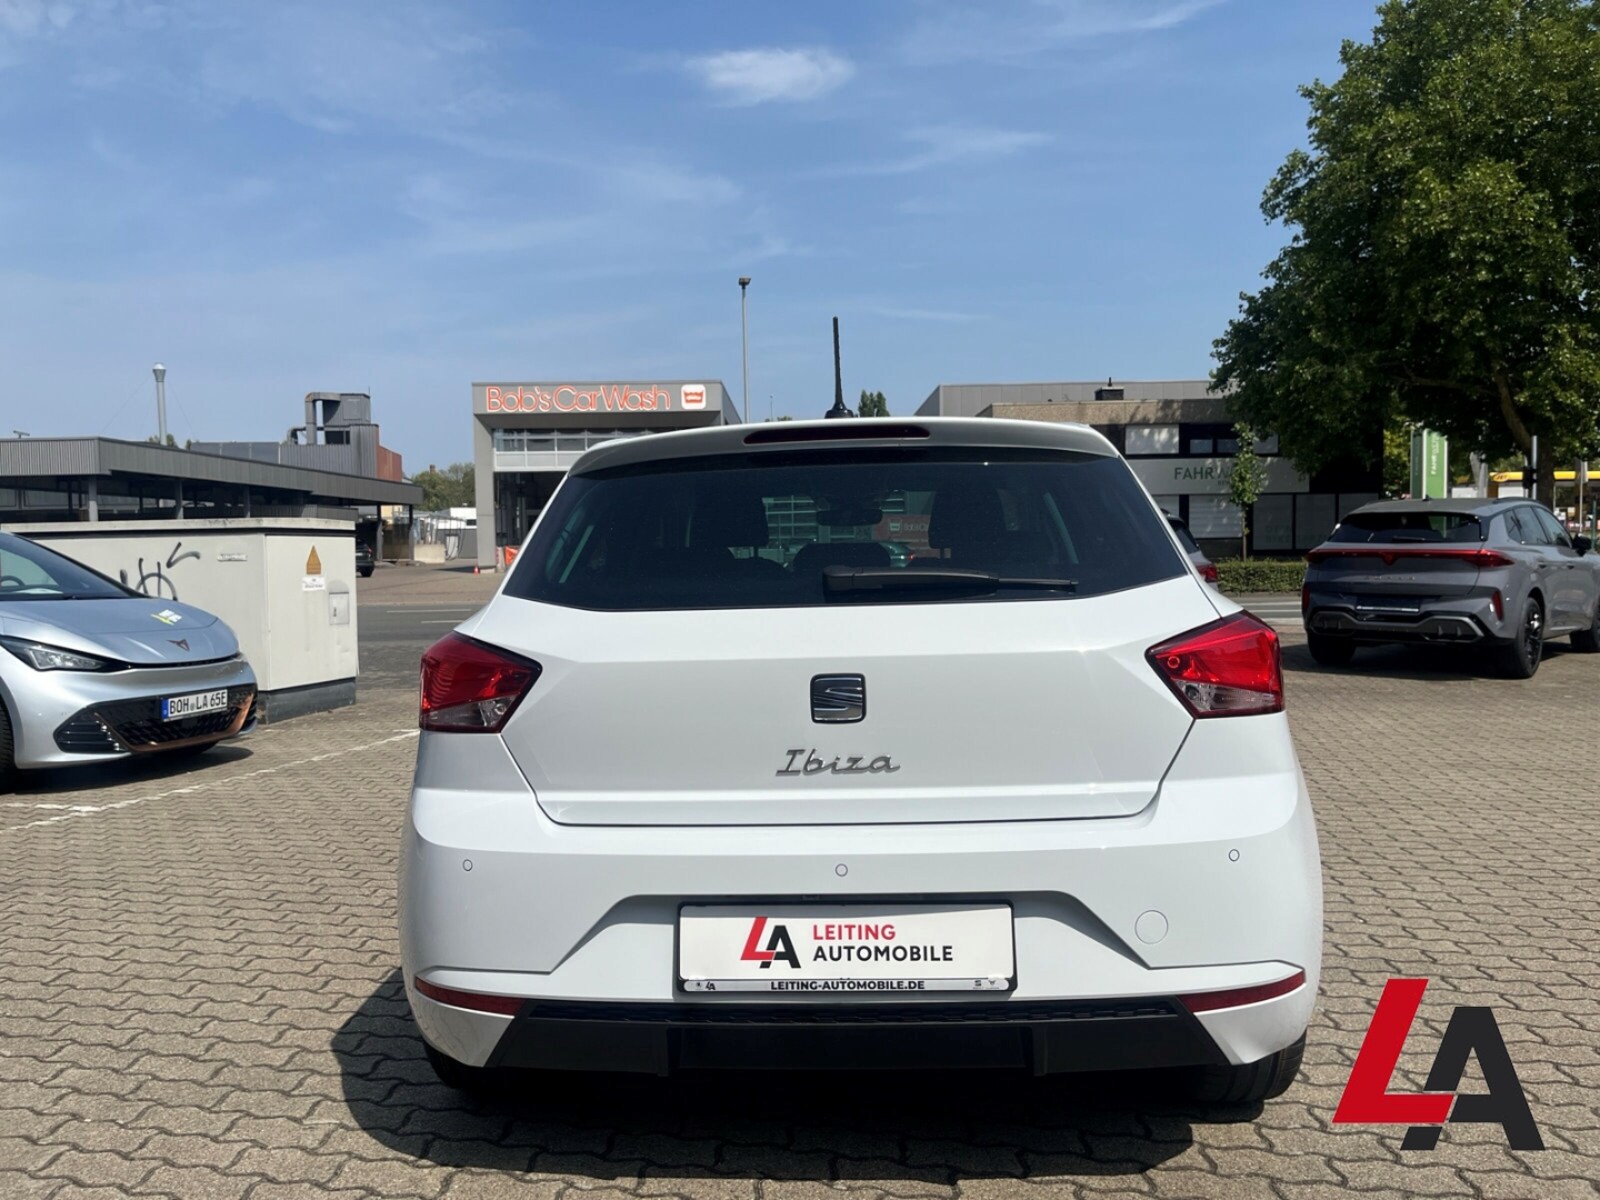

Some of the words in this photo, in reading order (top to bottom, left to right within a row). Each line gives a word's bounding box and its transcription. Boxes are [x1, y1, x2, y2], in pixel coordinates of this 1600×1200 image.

[486, 385, 552, 412] Bob's
[553, 385, 600, 411] Car
[600, 384, 671, 411] Wash
[169, 698, 190, 715] BOH
[196, 694, 209, 710] LA
[209, 691, 227, 707] 65E
[775, 748, 901, 777] Ibiza
[812, 924, 896, 941] LEITING
[812, 945, 954, 962] AUTOMOBILE
[770, 980, 925, 991] LEITING-AUTOMOBILE.DE
